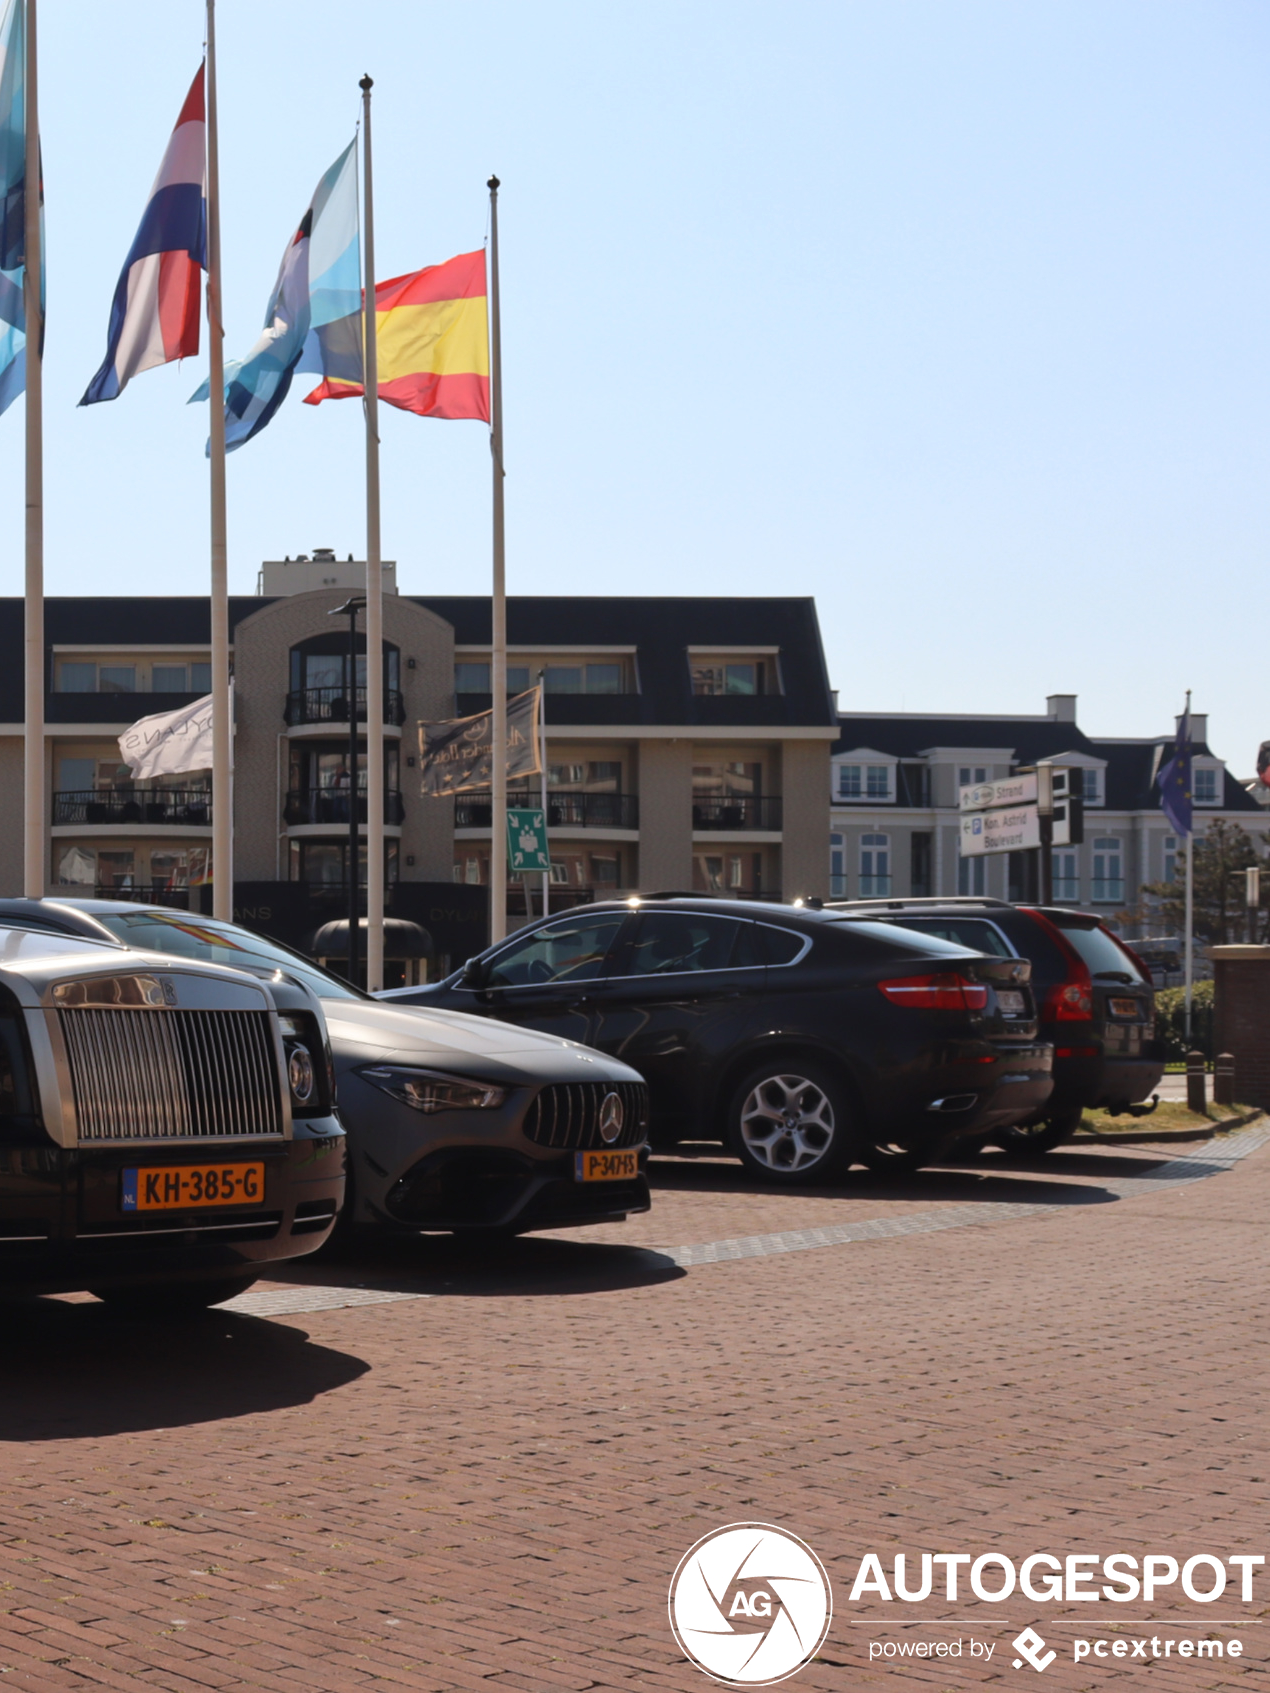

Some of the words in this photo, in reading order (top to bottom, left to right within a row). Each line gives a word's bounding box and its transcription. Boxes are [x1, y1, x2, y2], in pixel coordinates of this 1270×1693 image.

[996, 783, 1023, 799] Strand
[1003, 812, 1027, 828] Astrid
[984, 832, 1023, 848] Boulevard
[124, 1194, 136, 1204] NL
[145, 1168, 258, 1204] KH-385-G
